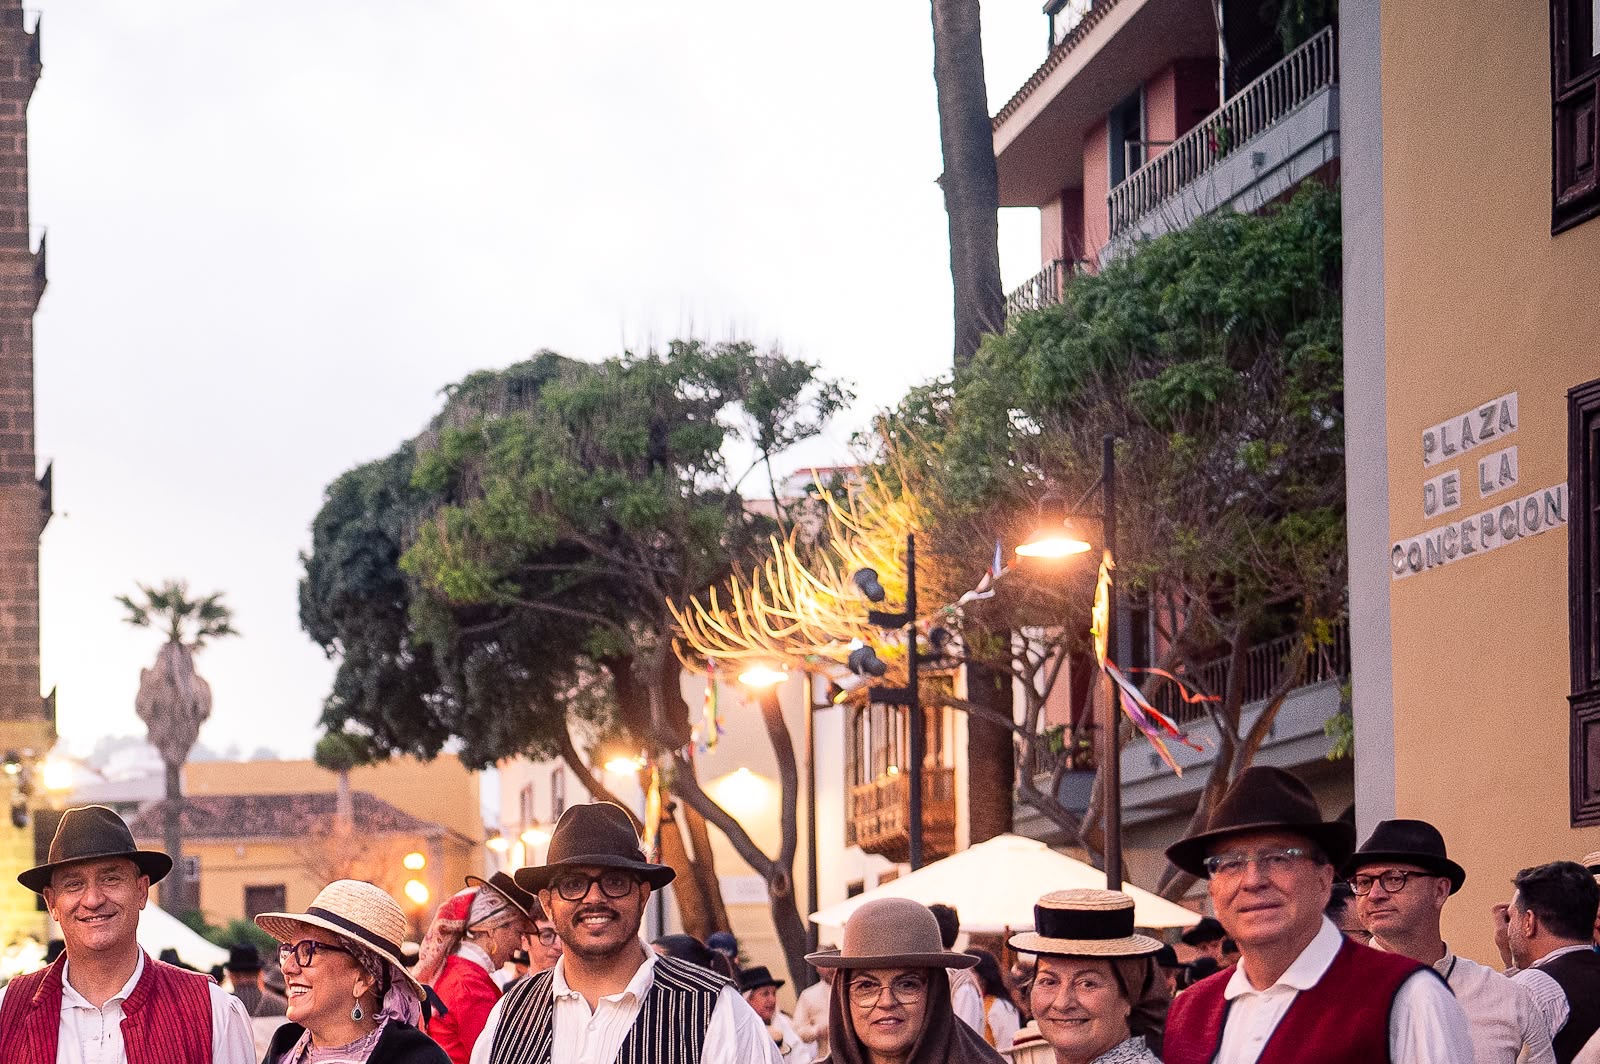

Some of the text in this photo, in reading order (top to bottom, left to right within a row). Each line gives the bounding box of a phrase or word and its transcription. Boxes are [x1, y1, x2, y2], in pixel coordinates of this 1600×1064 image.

[1423, 399, 1516, 463] PLAZA
[1423, 452, 1516, 516] DE LA
[1391, 487, 1567, 575] CONCEPCION
